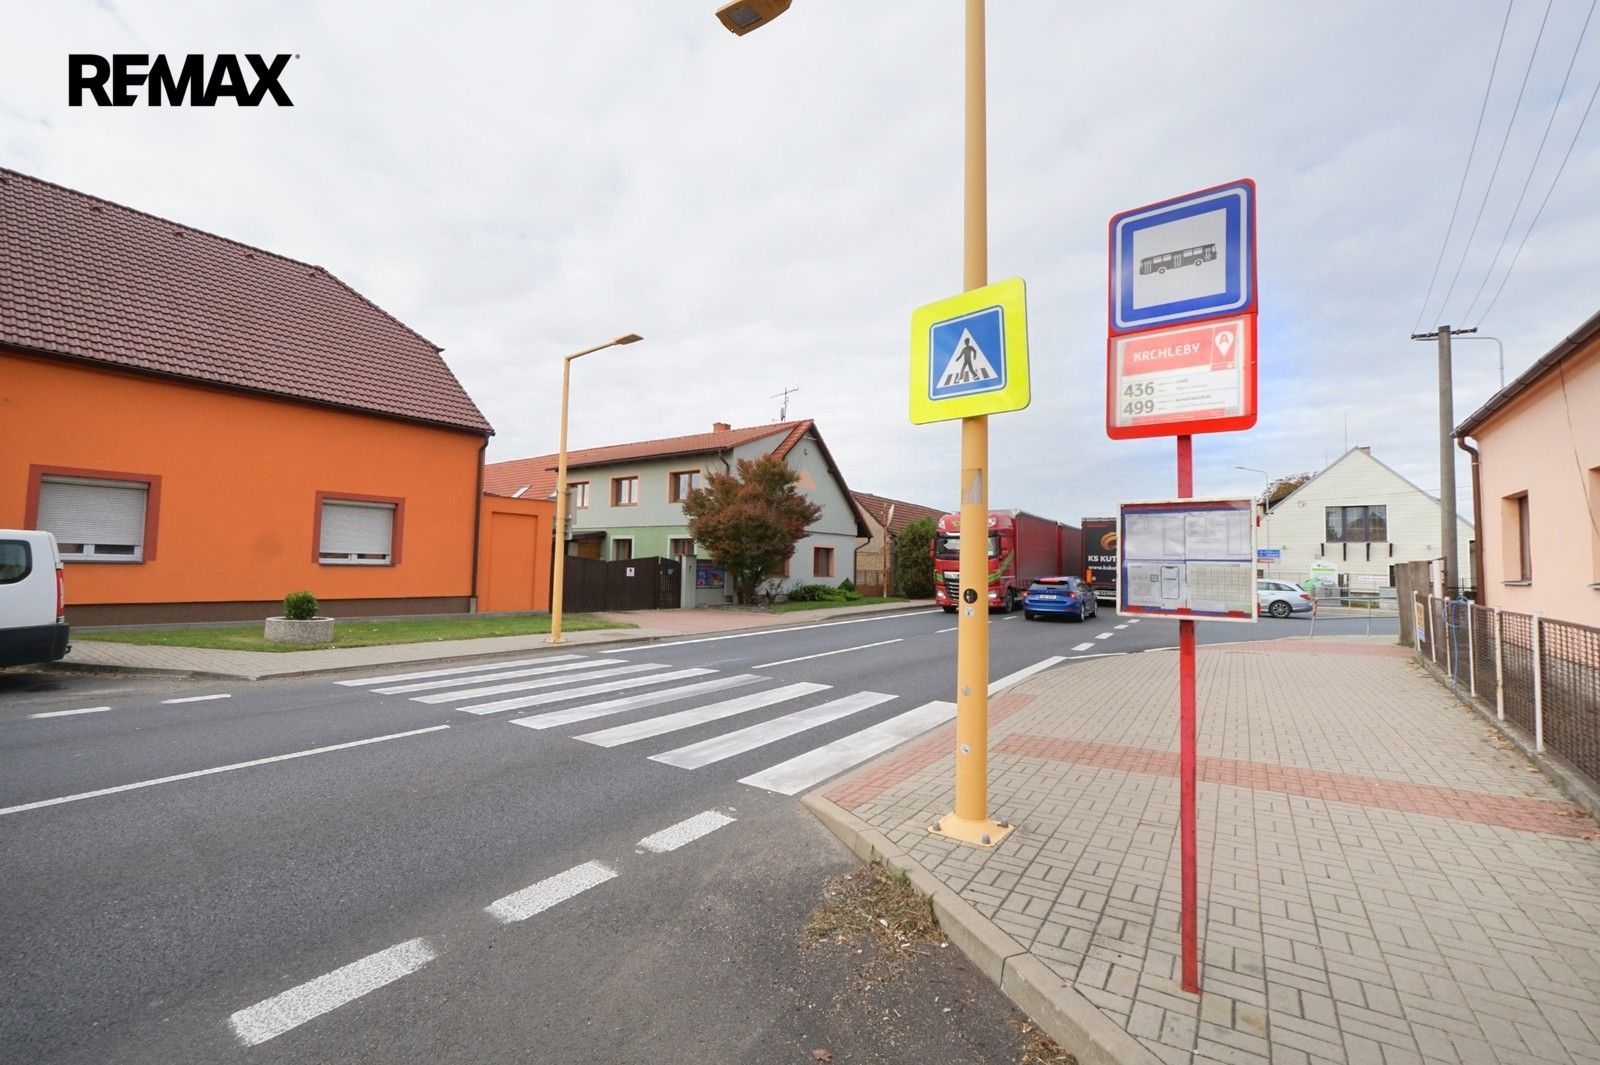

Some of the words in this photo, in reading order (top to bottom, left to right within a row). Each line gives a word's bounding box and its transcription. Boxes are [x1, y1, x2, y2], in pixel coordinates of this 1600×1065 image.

[1133, 343, 1201, 363] KRCHLEBY
[1124, 381, 1155, 398] 436
[1124, 399, 1155, 415] 499
